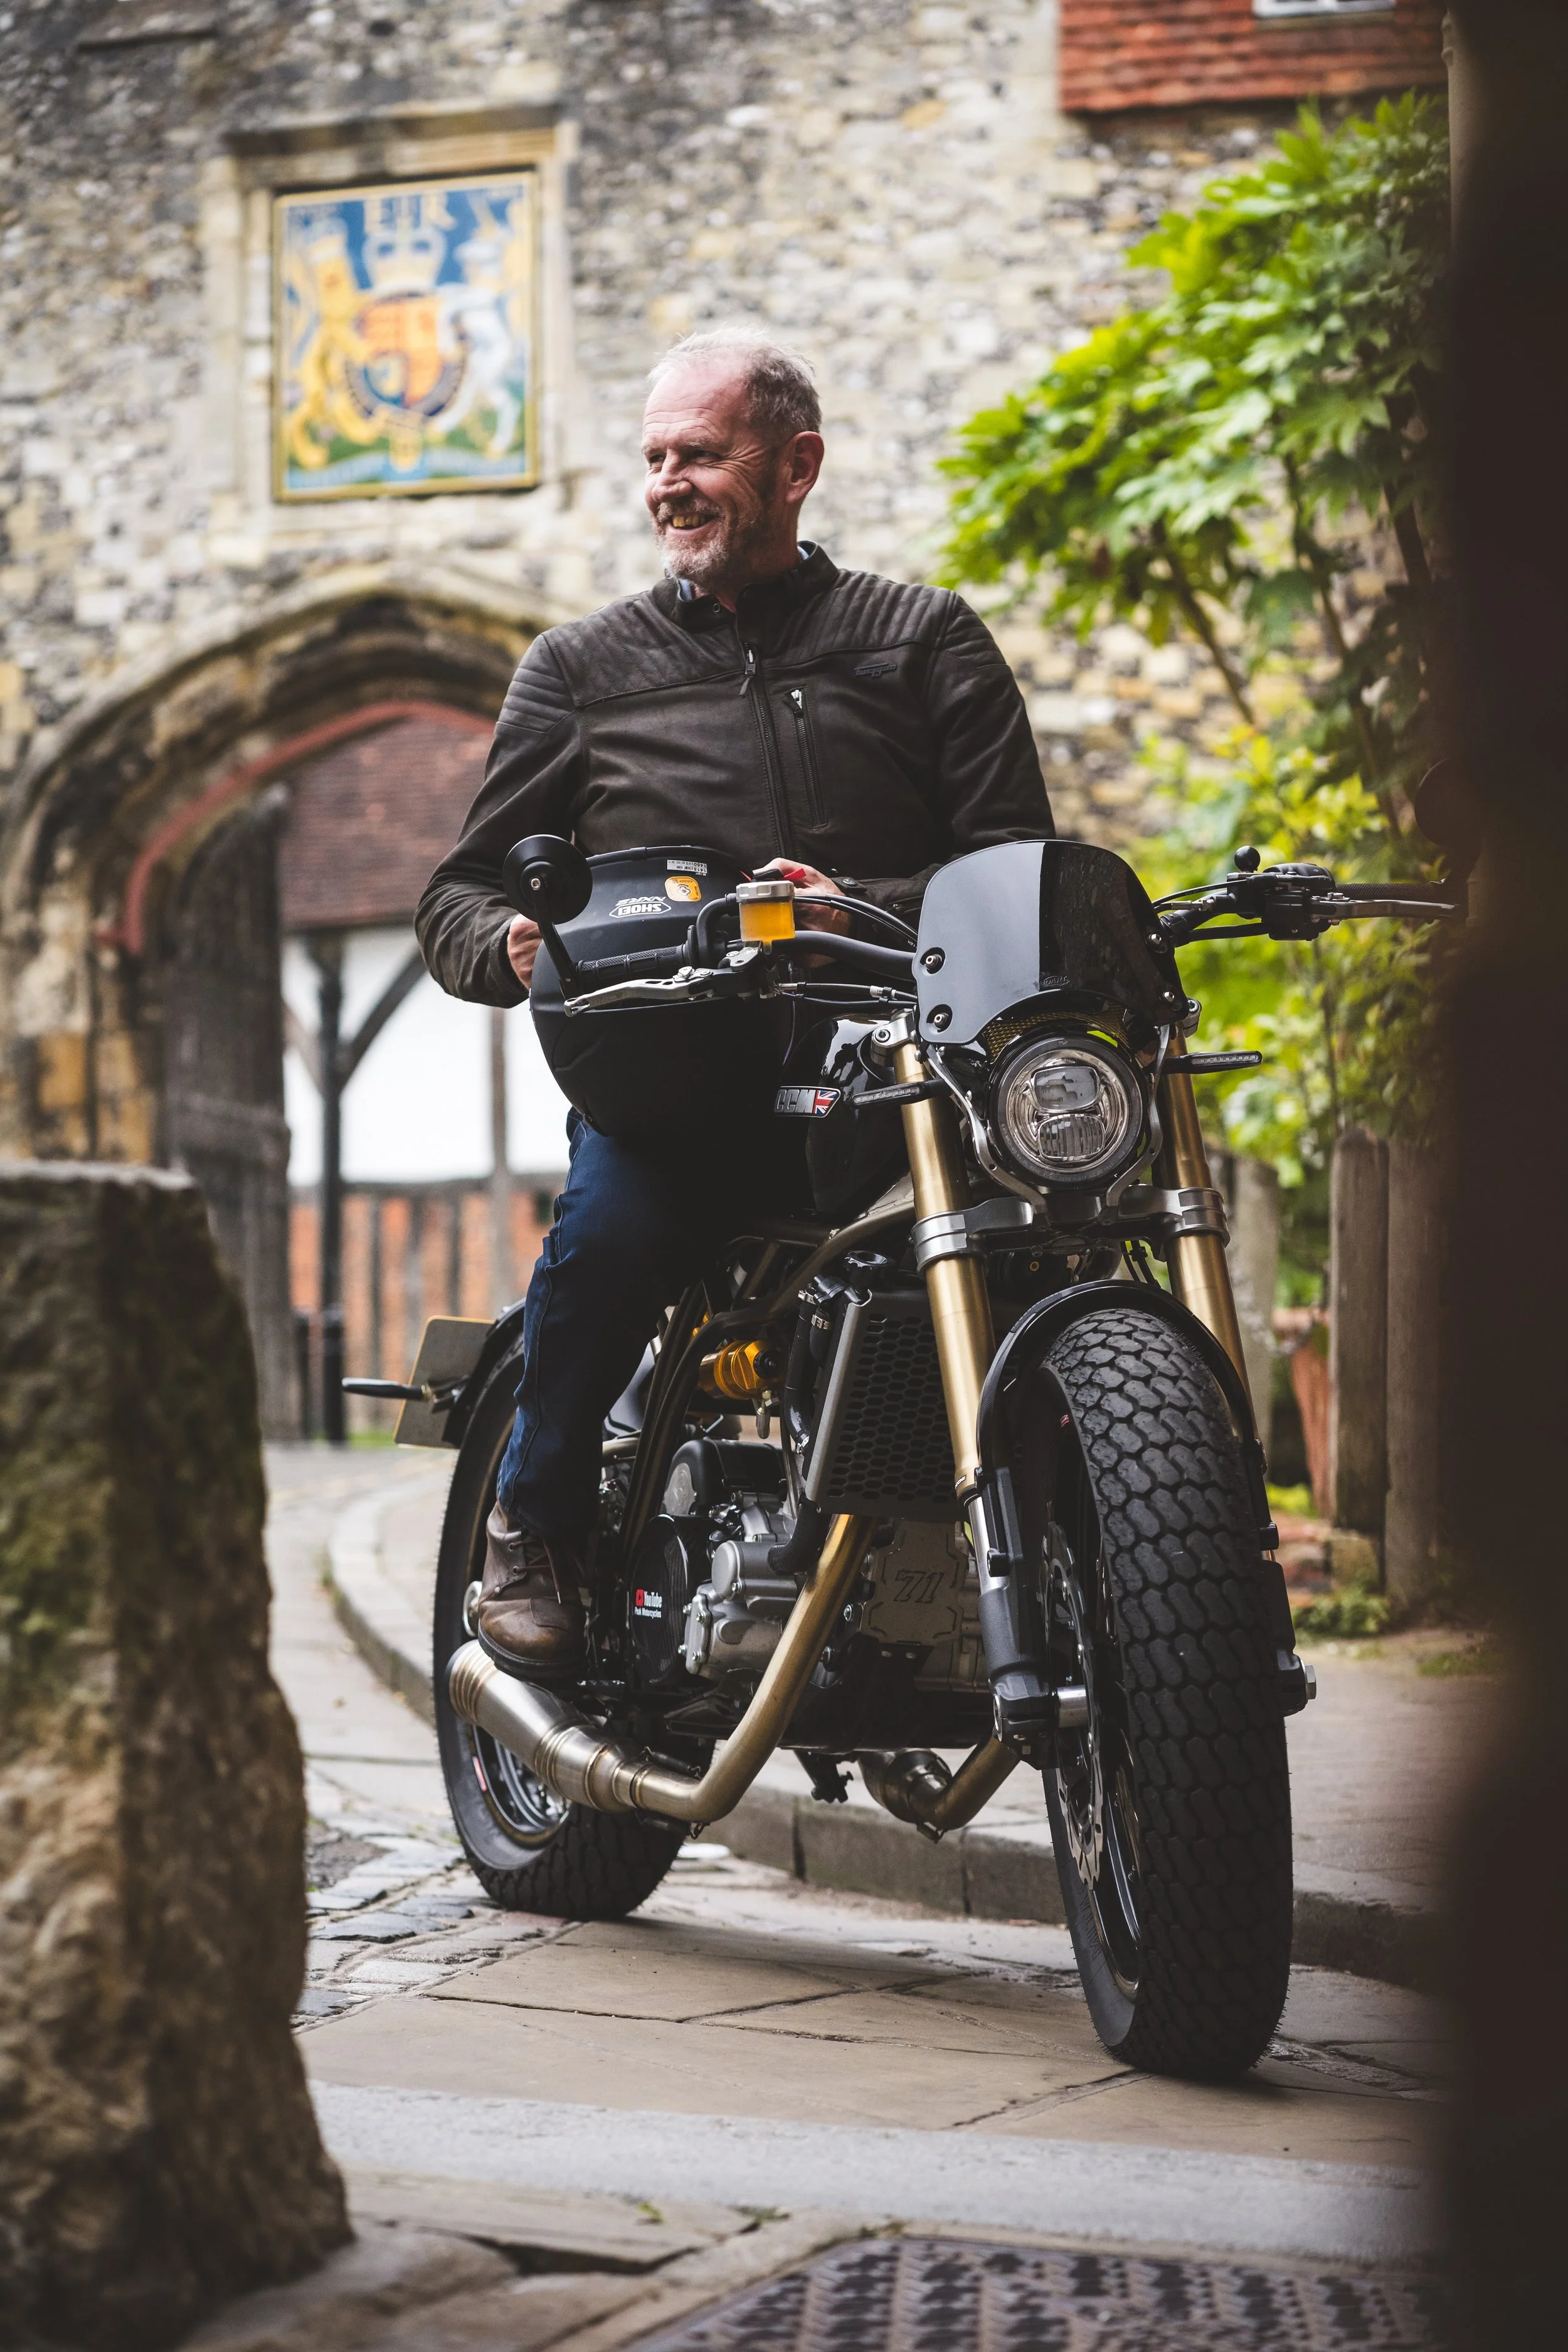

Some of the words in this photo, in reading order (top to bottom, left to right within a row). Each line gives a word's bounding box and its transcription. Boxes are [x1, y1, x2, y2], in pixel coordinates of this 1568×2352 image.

[618, 903, 662, 916] SHOEI
[774, 1089, 817, 1113] CCM
[893, 1570, 945, 1604] 71
[644, 1591, 662, 1608] YouTube
